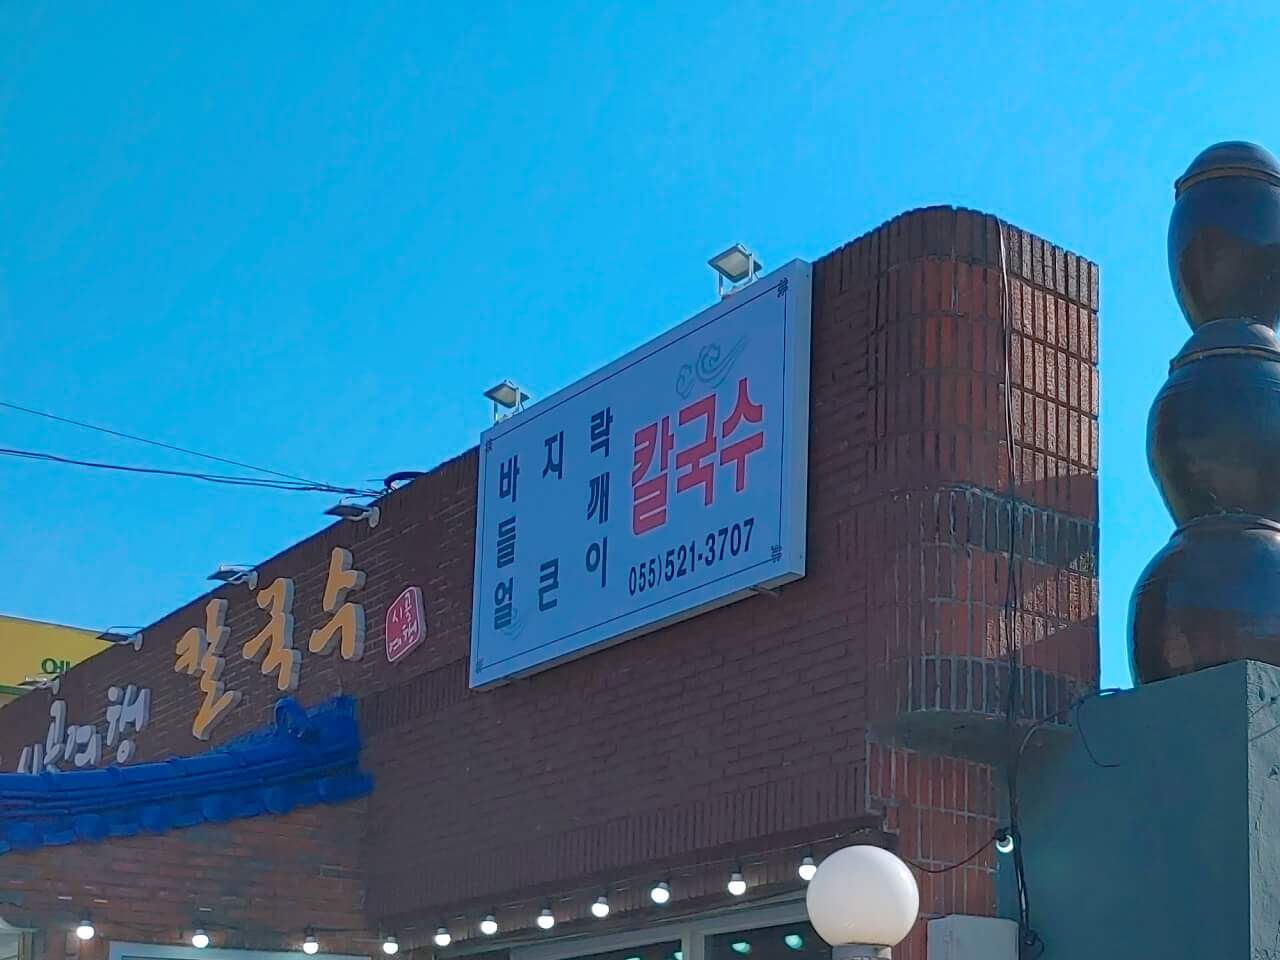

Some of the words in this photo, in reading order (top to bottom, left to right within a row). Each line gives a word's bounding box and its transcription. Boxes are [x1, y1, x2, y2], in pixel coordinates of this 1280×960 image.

[499, 407, 613, 502] 바지락
[632, 377, 764, 536] 칼국수
[497, 472, 610, 568] 들깨
[629, 517, 754, 596] 055)521-3707
[494, 536, 608, 630] 얼큰이
[174, 547, 367, 741] 칼국수
